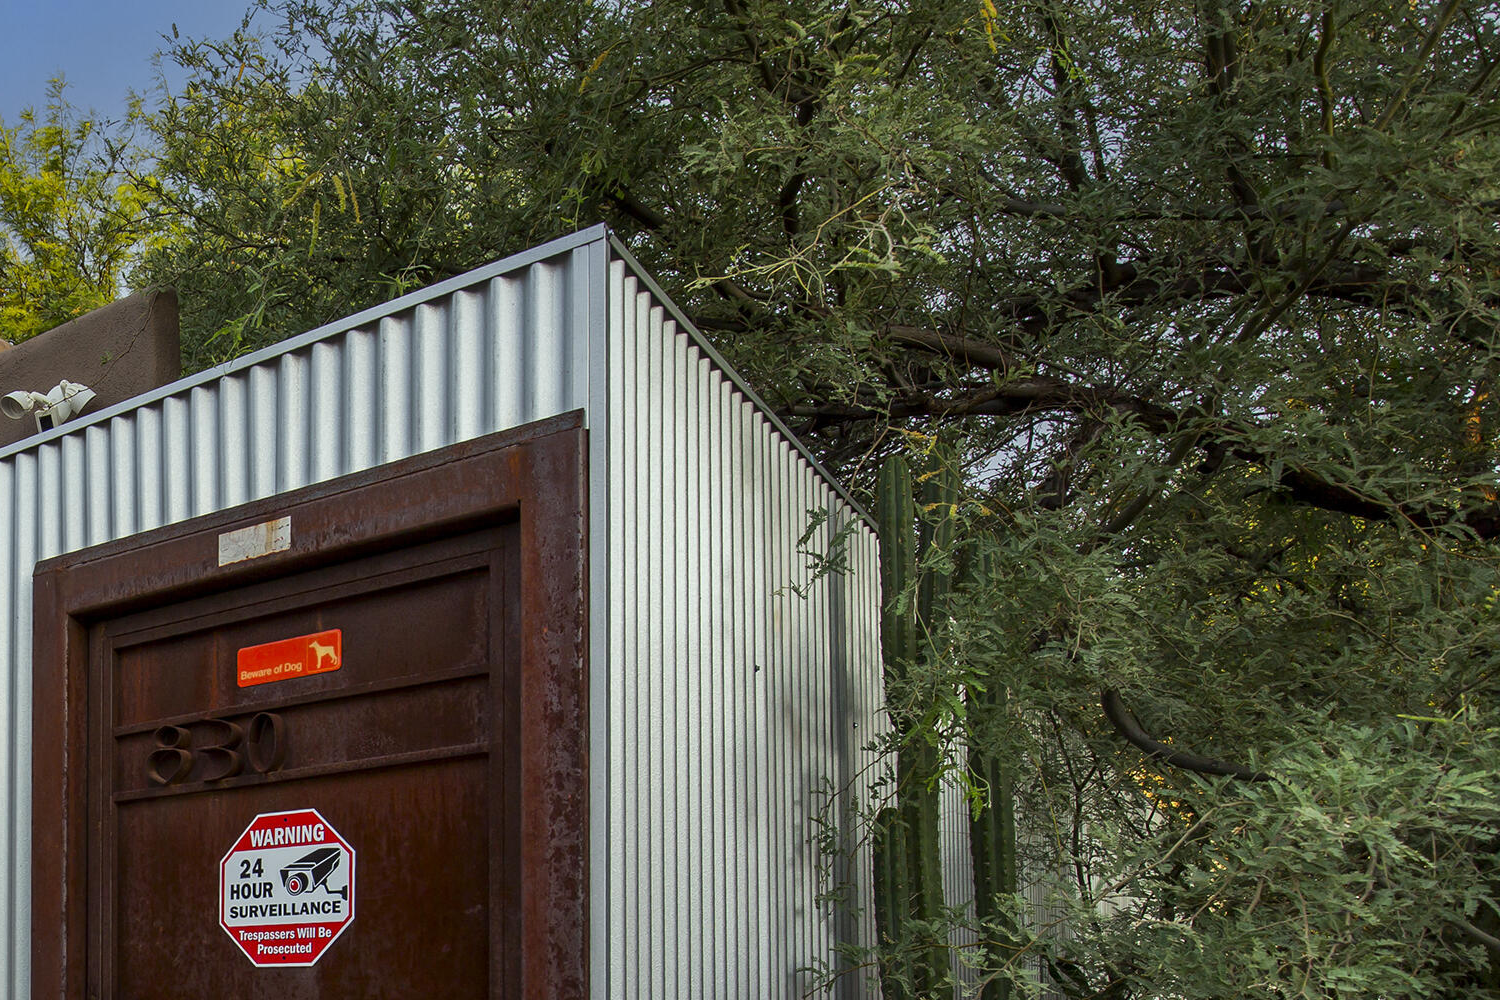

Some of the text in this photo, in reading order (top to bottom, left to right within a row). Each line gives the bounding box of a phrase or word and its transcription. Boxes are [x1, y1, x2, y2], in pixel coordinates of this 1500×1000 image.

[240, 662, 303, 680] Beware of Dog
[250, 823, 325, 848] WARNING
[240, 858, 264, 879] 24
[230, 882, 273, 900] HOUR
[229, 900, 342, 919] SURVEILLANCE
[239, 926, 332, 942] Trespassers Will Be
[257, 942, 312, 955] Prosecuted
